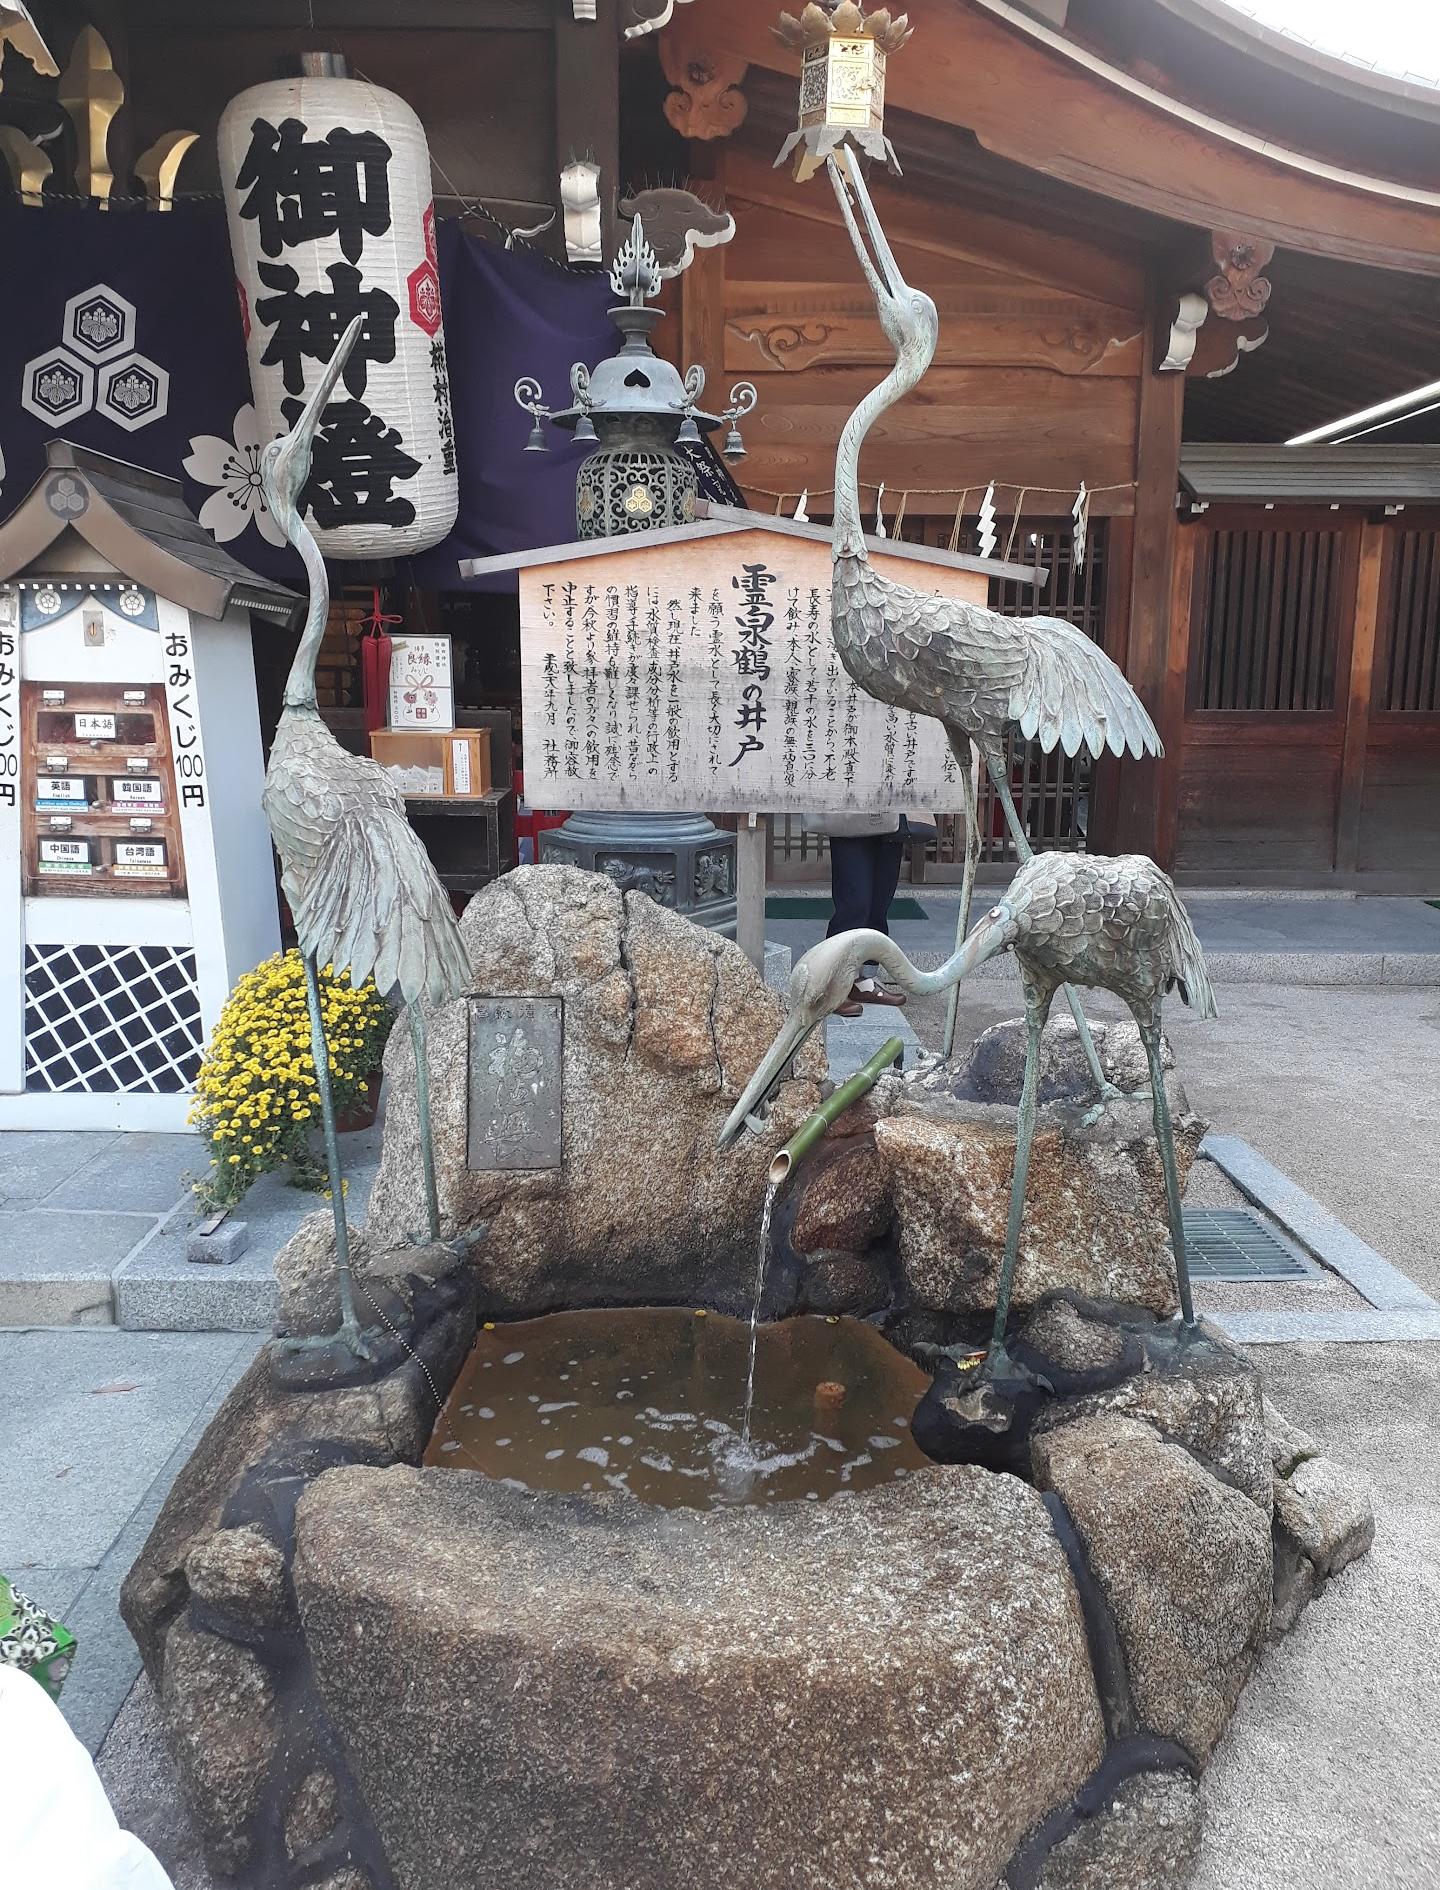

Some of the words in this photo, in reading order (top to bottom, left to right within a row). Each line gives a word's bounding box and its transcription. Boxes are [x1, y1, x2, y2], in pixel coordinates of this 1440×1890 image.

[688, 587, 702, 636] 来ました
[729, 563, 777, 767] 霊泉鶴の井戸
[78, 717, 114, 730] 日本語
[51, 781, 71, 791] 英語
[122, 782, 153, 793] 韓国語
[50, 843, 80, 854] 中国語
[125, 846, 155, 857] 台湾語
